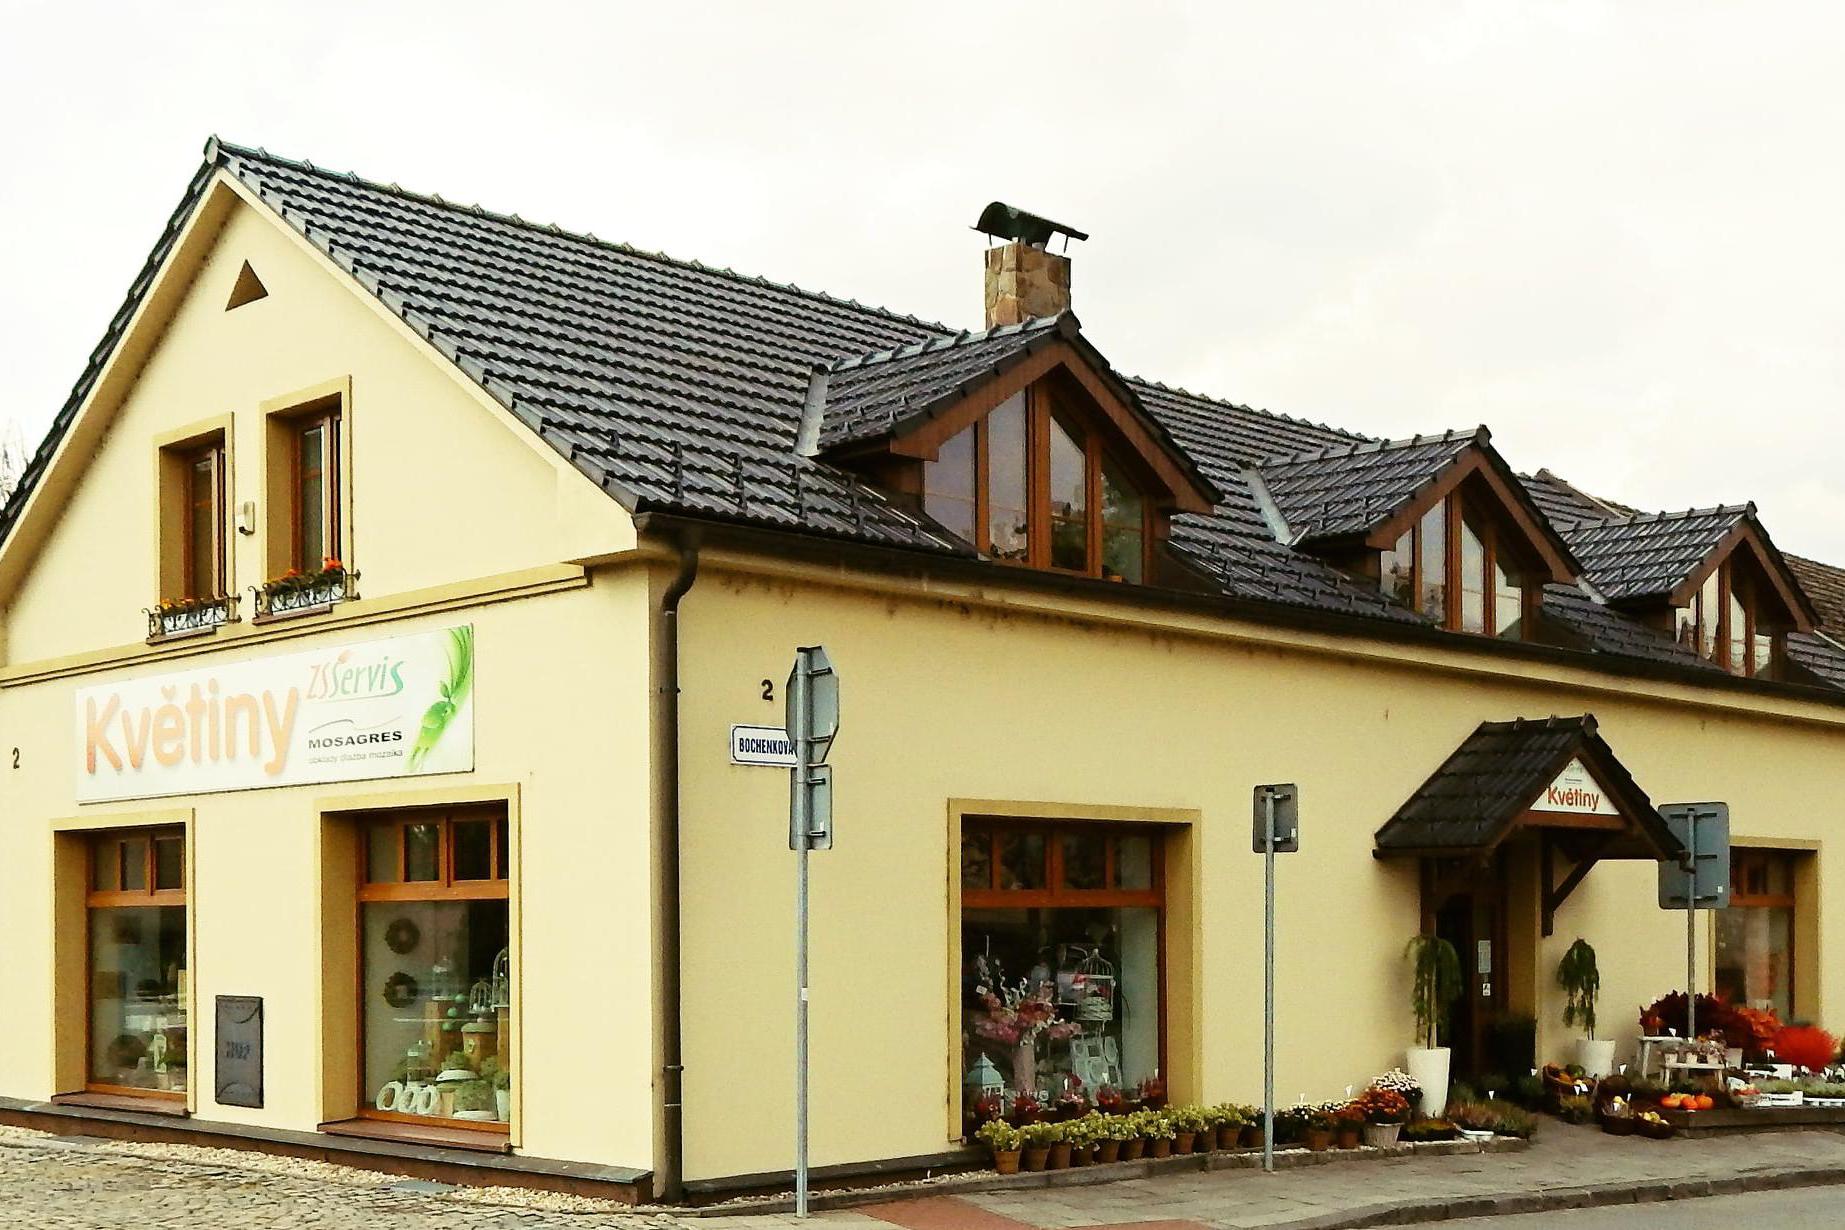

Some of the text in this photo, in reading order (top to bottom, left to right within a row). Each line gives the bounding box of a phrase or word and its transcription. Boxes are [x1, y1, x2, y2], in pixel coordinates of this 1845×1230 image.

[761, 678, 774, 702] 2
[86, 677, 300, 776] Květiny
[308, 730, 403, 749] MOSAGRES
[12, 747, 20, 769] 2
[1547, 785, 1600, 812] Květiny
